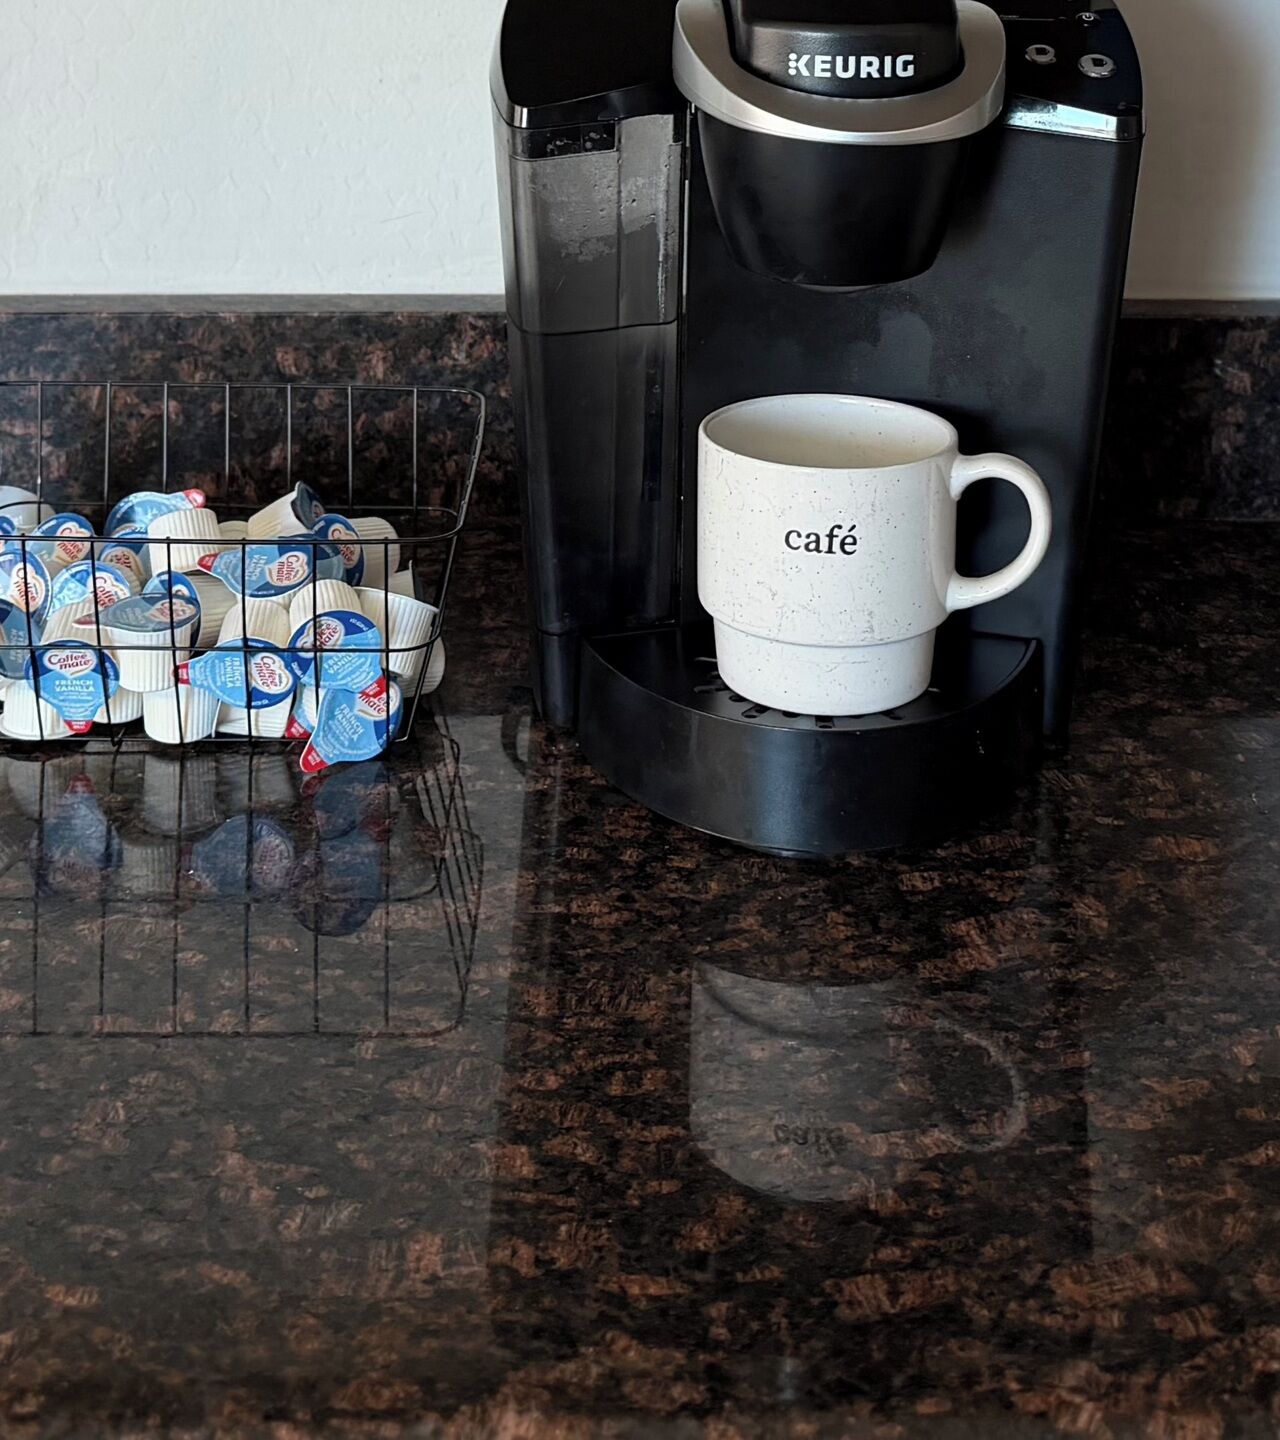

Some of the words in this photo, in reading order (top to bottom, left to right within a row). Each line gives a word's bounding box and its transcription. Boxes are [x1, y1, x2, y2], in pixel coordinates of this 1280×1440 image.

[788, 53, 915, 79] KEURIG
[784, 524, 858, 555] café
[276, 561, 286, 582] mate
[285, 554, 299, 582] Coffee
[47, 653, 88, 665] Coffee
[59, 660, 91, 670] mate
[224, 657, 234, 688] VANILLA
[232, 657, 242, 687] FRENCH
[261, 655, 278, 687] Coffee
[253, 662, 271, 689] mate
[334, 707, 360, 741] VANILLA
[340, 703, 365, 735] FRENCH
